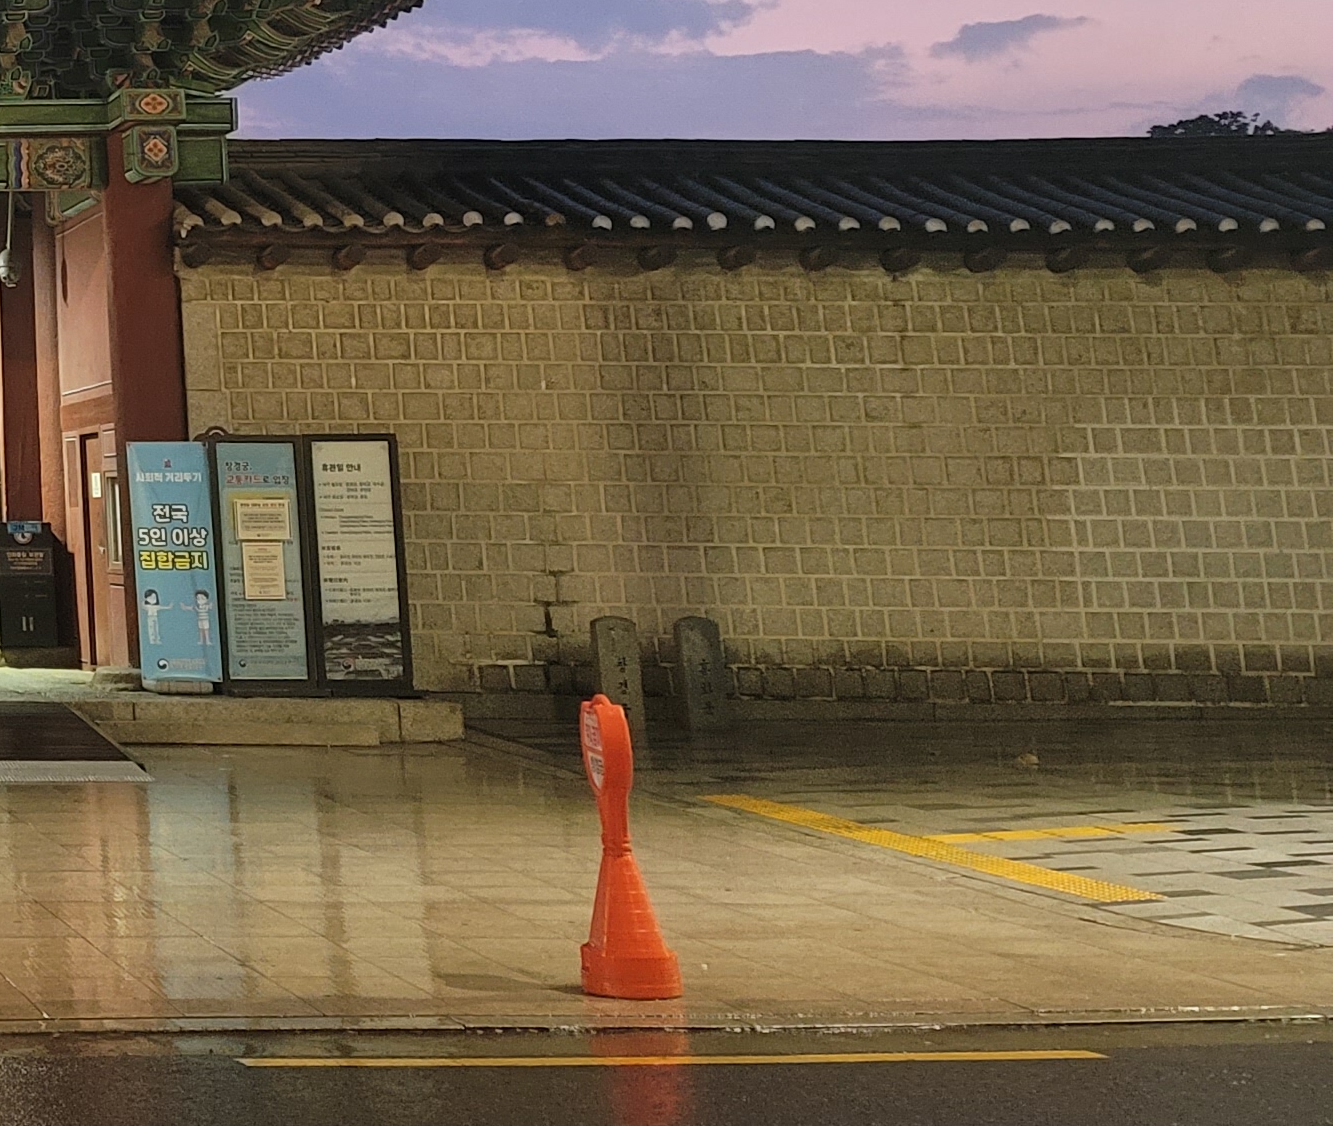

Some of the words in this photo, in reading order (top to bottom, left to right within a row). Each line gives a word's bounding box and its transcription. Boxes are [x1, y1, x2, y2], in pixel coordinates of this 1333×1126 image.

[135, 472, 163, 482] 사회적
[165, 472, 202, 482] 거리두기
[152, 504, 189, 524] 전국
[138, 527, 168, 547] 5인
[171, 527, 208, 547] 이상
[139, 550, 209, 571] 집합금지
